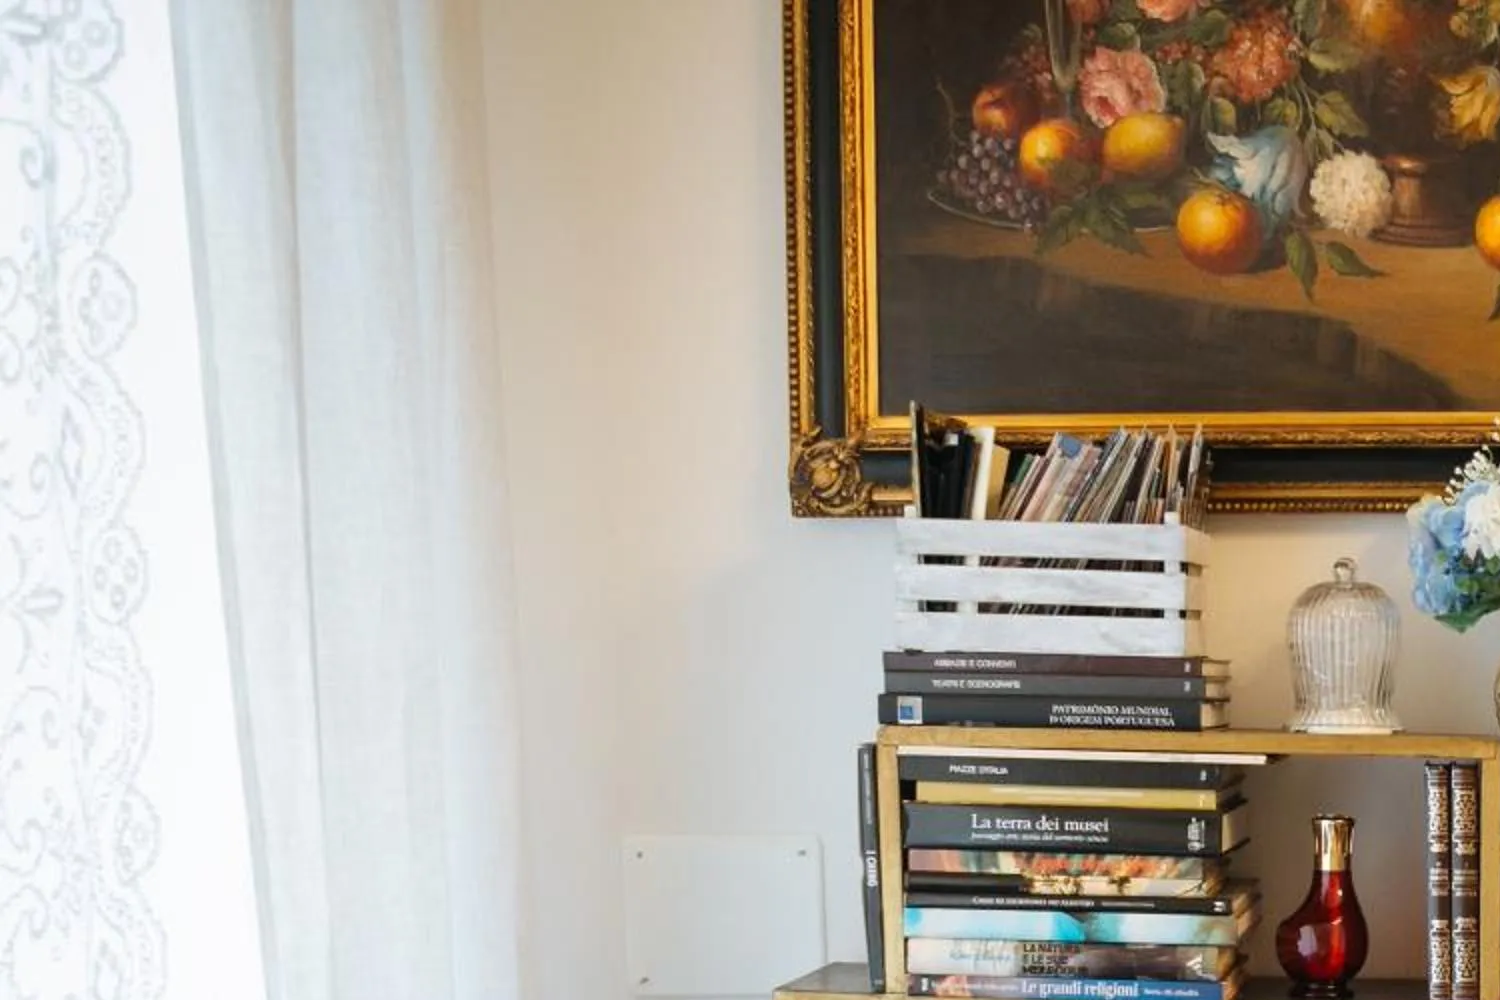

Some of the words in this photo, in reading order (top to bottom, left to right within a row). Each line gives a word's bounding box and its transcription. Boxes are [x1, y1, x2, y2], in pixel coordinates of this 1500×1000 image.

[971, 813, 992, 831] La
[995, 816, 1032, 831] terra
[1035, 814, 1060, 832] dei
[1064, 816, 1110, 833] musei
[1022, 980, 1037, 993] Le
[1040, 981, 1082, 998] grandi
[1084, 981, 1140, 998] religioni
